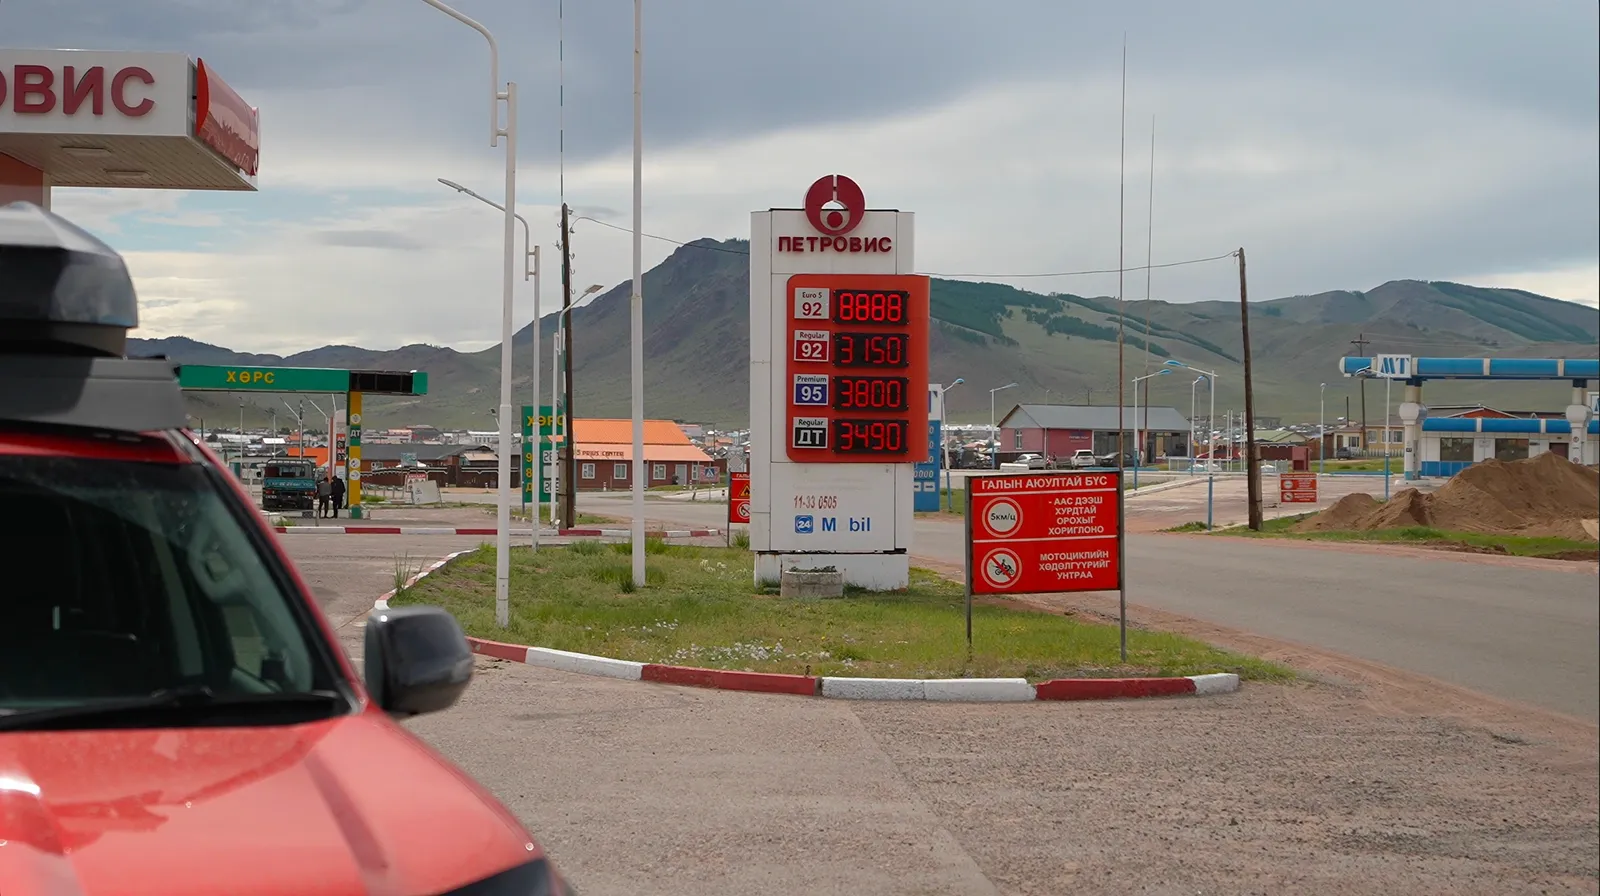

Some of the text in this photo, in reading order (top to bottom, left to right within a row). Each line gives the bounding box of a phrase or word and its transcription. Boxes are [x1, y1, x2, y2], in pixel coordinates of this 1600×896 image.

[0, 64, 156, 117] ВИС
[778, 236, 893, 252] ПЕТРОВИС
[802, 291, 823, 299] Euro 5
[802, 302, 822, 316] 92
[839, 293, 902, 321] 8888
[799, 331, 825, 340] Regular
[801, 342, 823, 358] 92
[841, 336, 902, 364] 3150
[226, 371, 275, 384] ХӨРС
[796, 375, 827, 383] Premium
[801, 386, 823, 401] 95
[841, 380, 902, 407] 3800
[798, 418, 824, 427] Regular
[350, 430, 360, 438] ДТ
[797, 429, 824, 445] ДТ
[841, 422, 901, 450] 3490
[981, 475, 1108, 490] ГАЛЫН АЮУЛТАЙ БҮС
[793, 495, 838, 510] 11-33 0505
[1054, 497, 1073, 506] ААС
[1074, 496, 1103, 506] ДЭЭШ
[1055, 505, 1097, 516] ХУРДТАЙ
[990, 512, 1017, 522] 5км/ц
[1056, 516, 1096, 525] ОРОХЫГ
[798, 520, 811, 529] 24
[1048, 525, 1105, 536] ХОРИГЛОНО
[1040, 550, 1109, 561] МОТОЦИКЛИЙН
[1039, 560, 1111, 572] ХӨДӨЛГҮҮРИЙГ
[1056, 571, 1093, 580] УНТРАА
